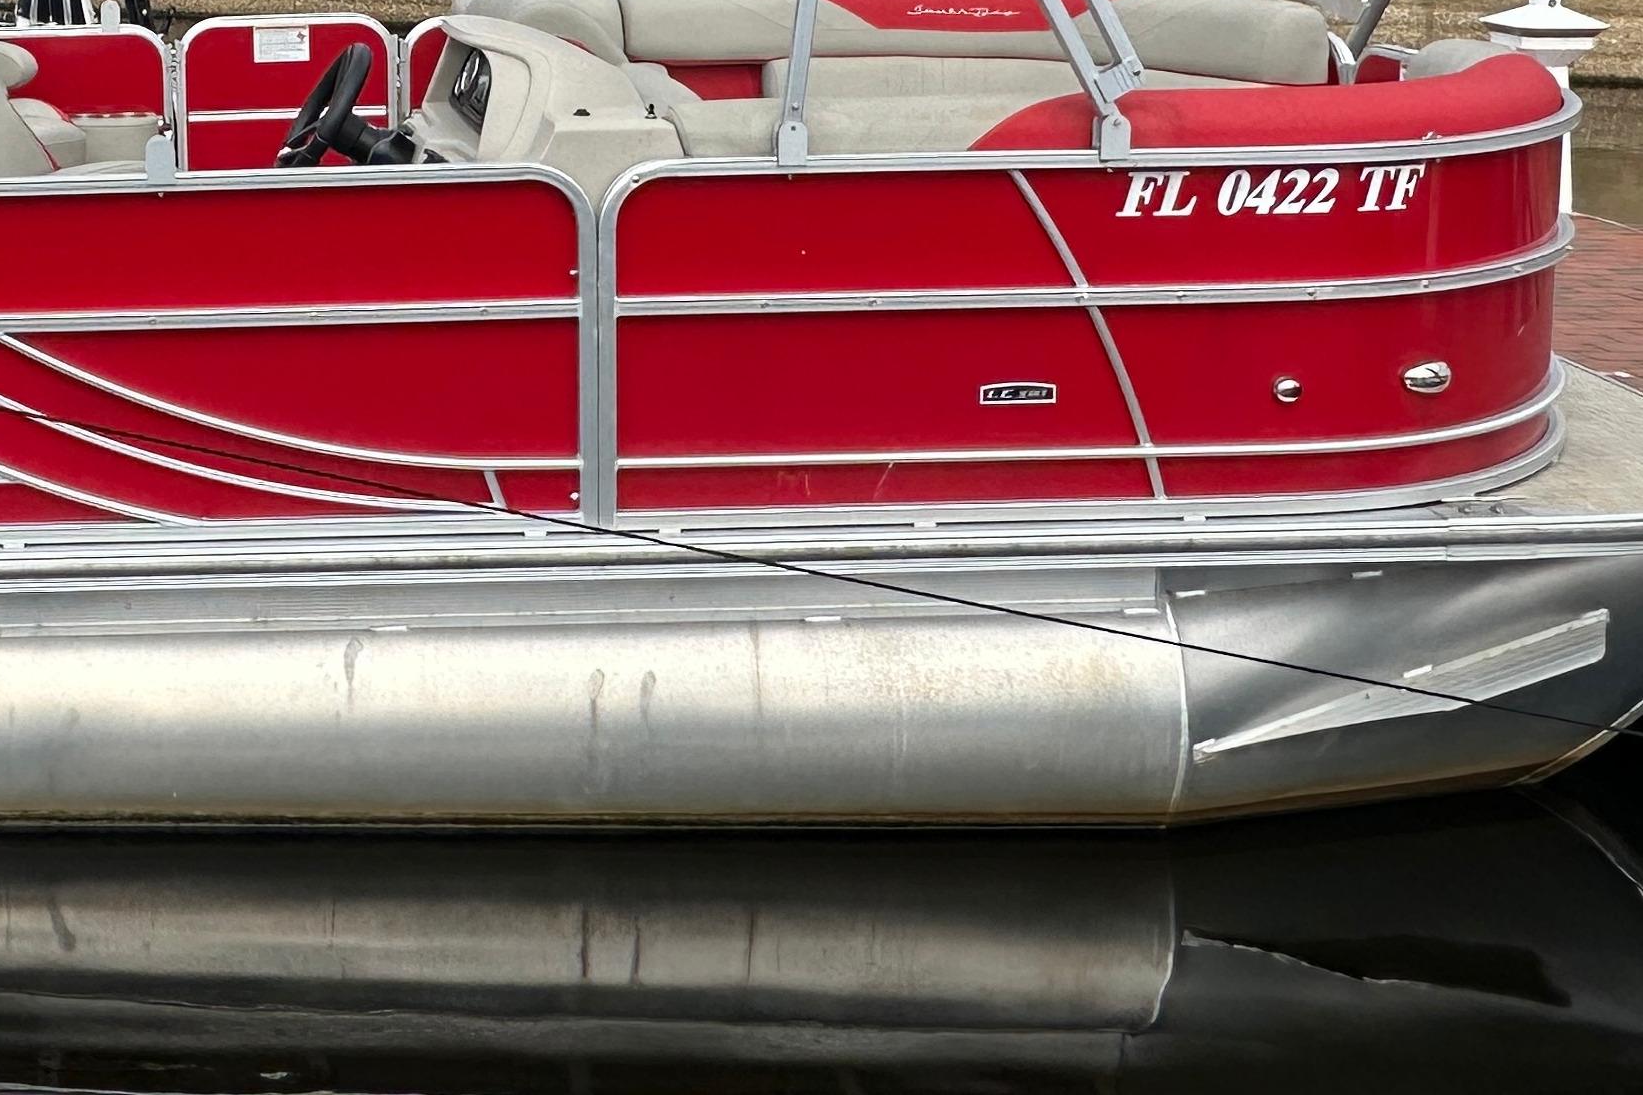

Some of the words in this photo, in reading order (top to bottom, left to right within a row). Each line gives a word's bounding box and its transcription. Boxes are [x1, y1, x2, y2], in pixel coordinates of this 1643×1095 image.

[1115, 171, 1197, 217] FL
[1217, 168, 1340, 216] 0422
[1357, 163, 1426, 212] TF
